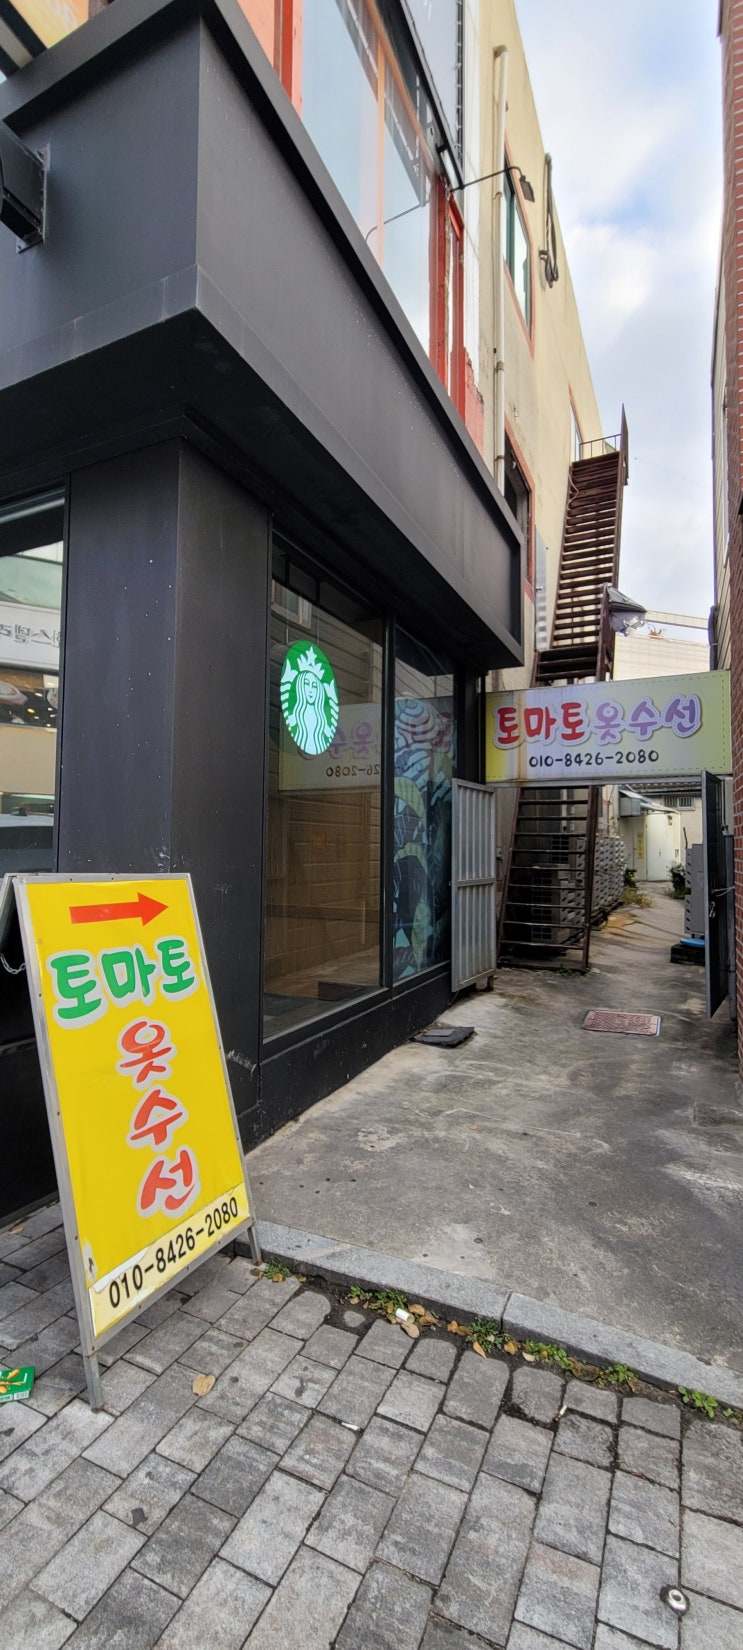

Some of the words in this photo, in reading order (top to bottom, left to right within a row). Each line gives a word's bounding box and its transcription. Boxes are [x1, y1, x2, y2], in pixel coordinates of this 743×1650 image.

[528, 749, 660, 768] 010-8426-2080
[50, 939, 195, 1020] 토마토
[108, 1196, 239, 1309] 010-8426-2080
